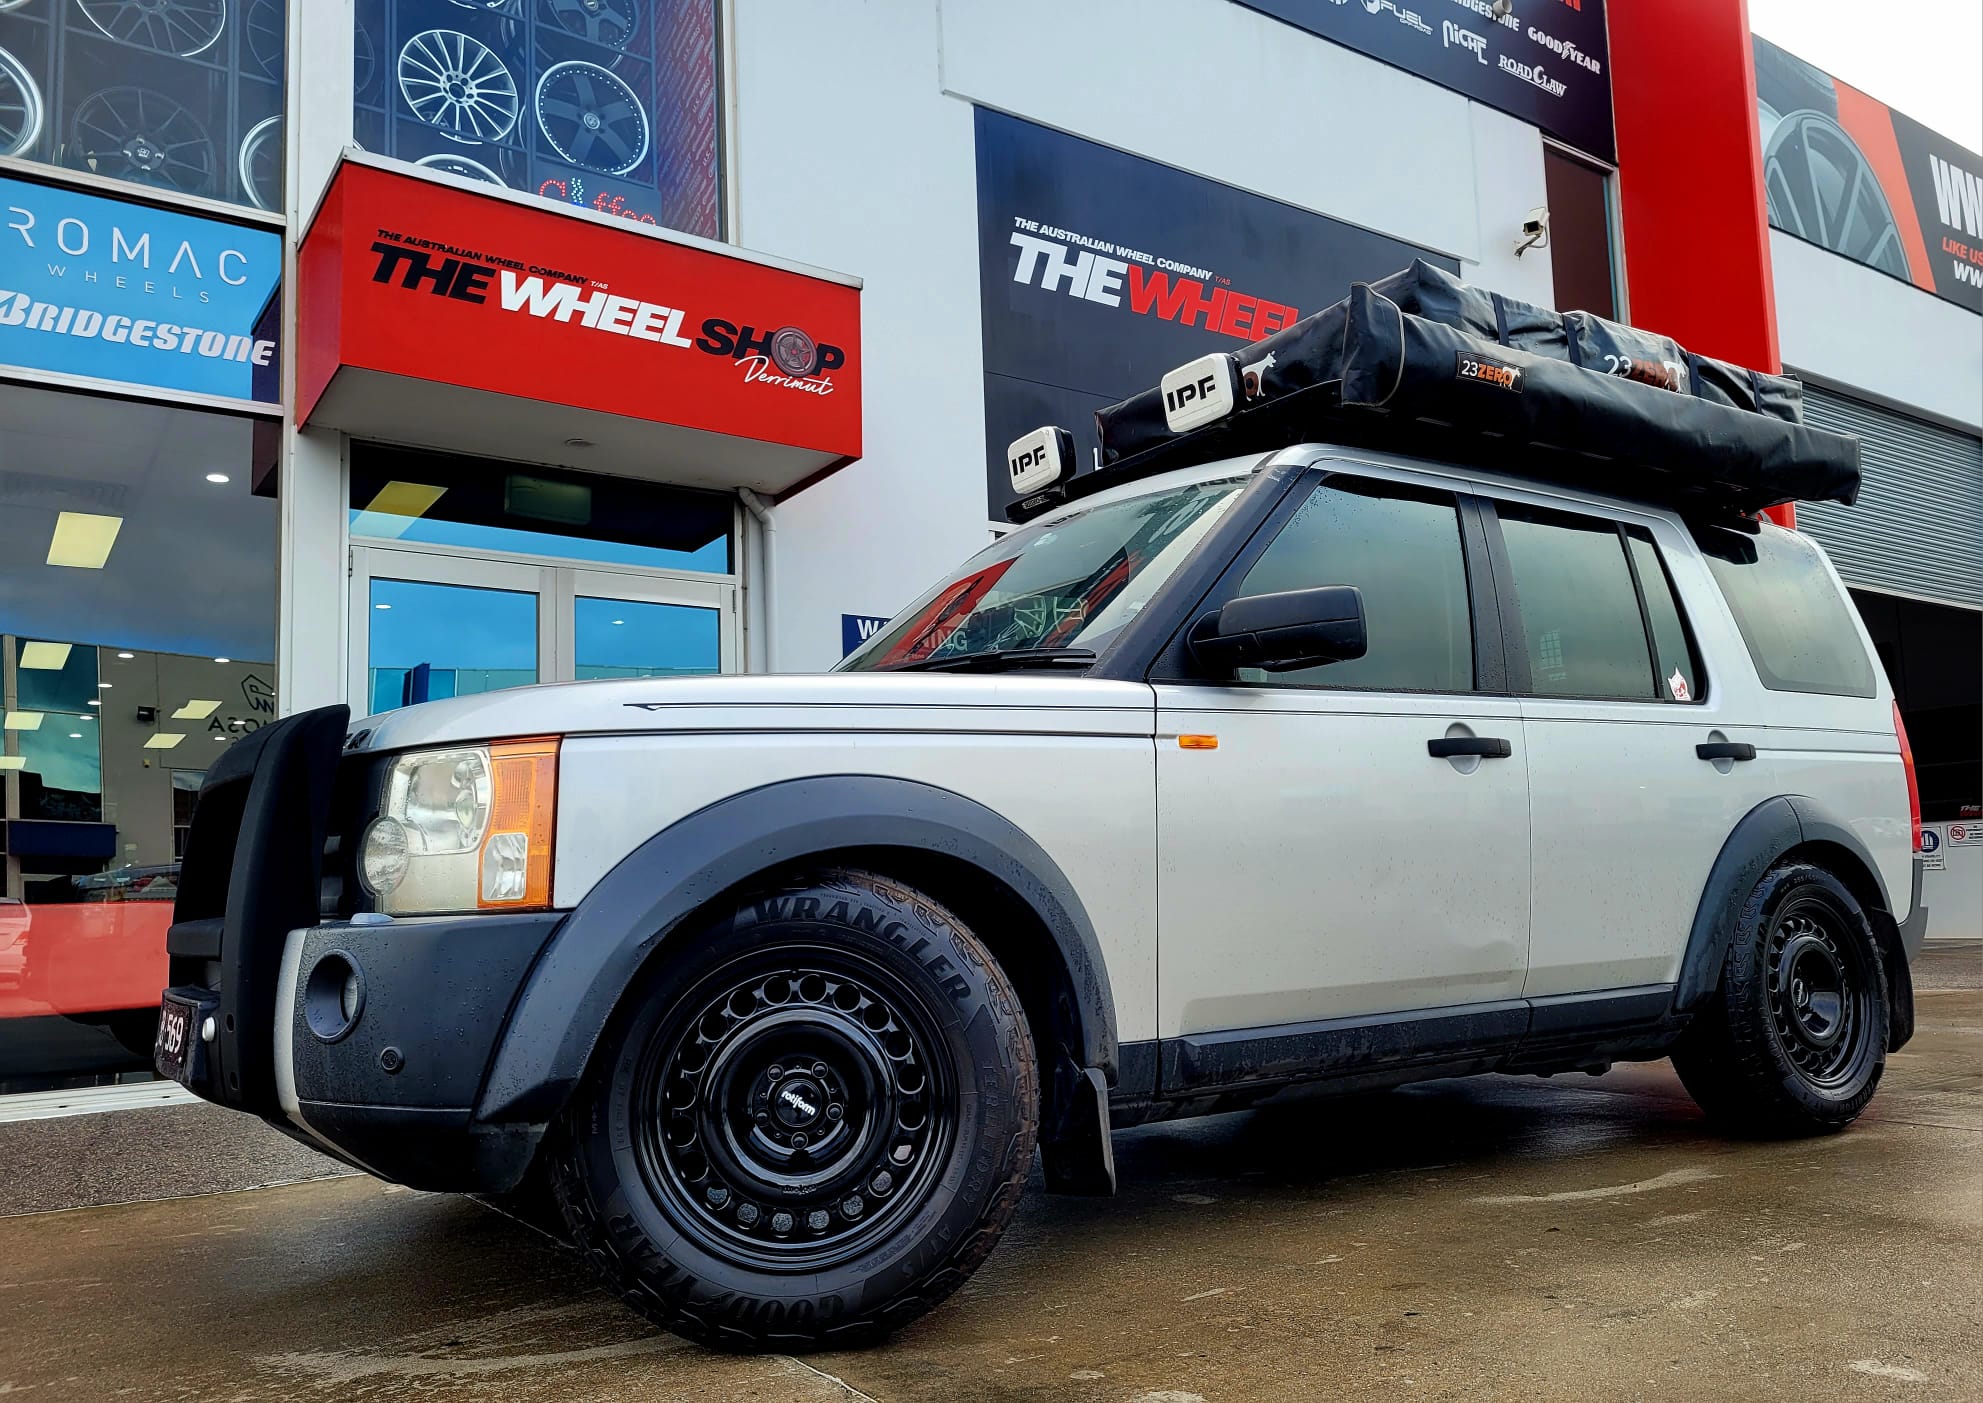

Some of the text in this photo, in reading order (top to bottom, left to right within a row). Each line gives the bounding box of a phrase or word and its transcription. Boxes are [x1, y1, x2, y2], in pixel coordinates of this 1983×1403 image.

[8, 206, 247, 286] ROMAC
[377, 229, 402, 242] THE
[404, 236, 482, 261] AUSTRALIAN
[484, 254, 526, 271] WHEEL
[528, 265, 588, 284] COMPANY
[1014, 217, 1038, 232] THE
[1039, 224, 1114, 254] AUSTRALIAN
[1116, 246, 1155, 266] WHEEL
[1157, 257, 1213, 280] COMPANY
[1943, 237, 1968, 259] LIKE
[47, 263, 209, 303] WHEELS
[1010, 232, 1129, 307] THE
[370, 241, 496, 304] THE
[501, 270, 692, 349] WHEEL
[734, 355, 834, 395] Derrimut
[1461, 360, 1513, 385] 23ZERO
[1166, 375, 1217, 412] IPF
[1012, 445, 1046, 478] IPF
[754, 896, 972, 1000] WRANGLER
[781, 1090, 815, 1116] rotiform
